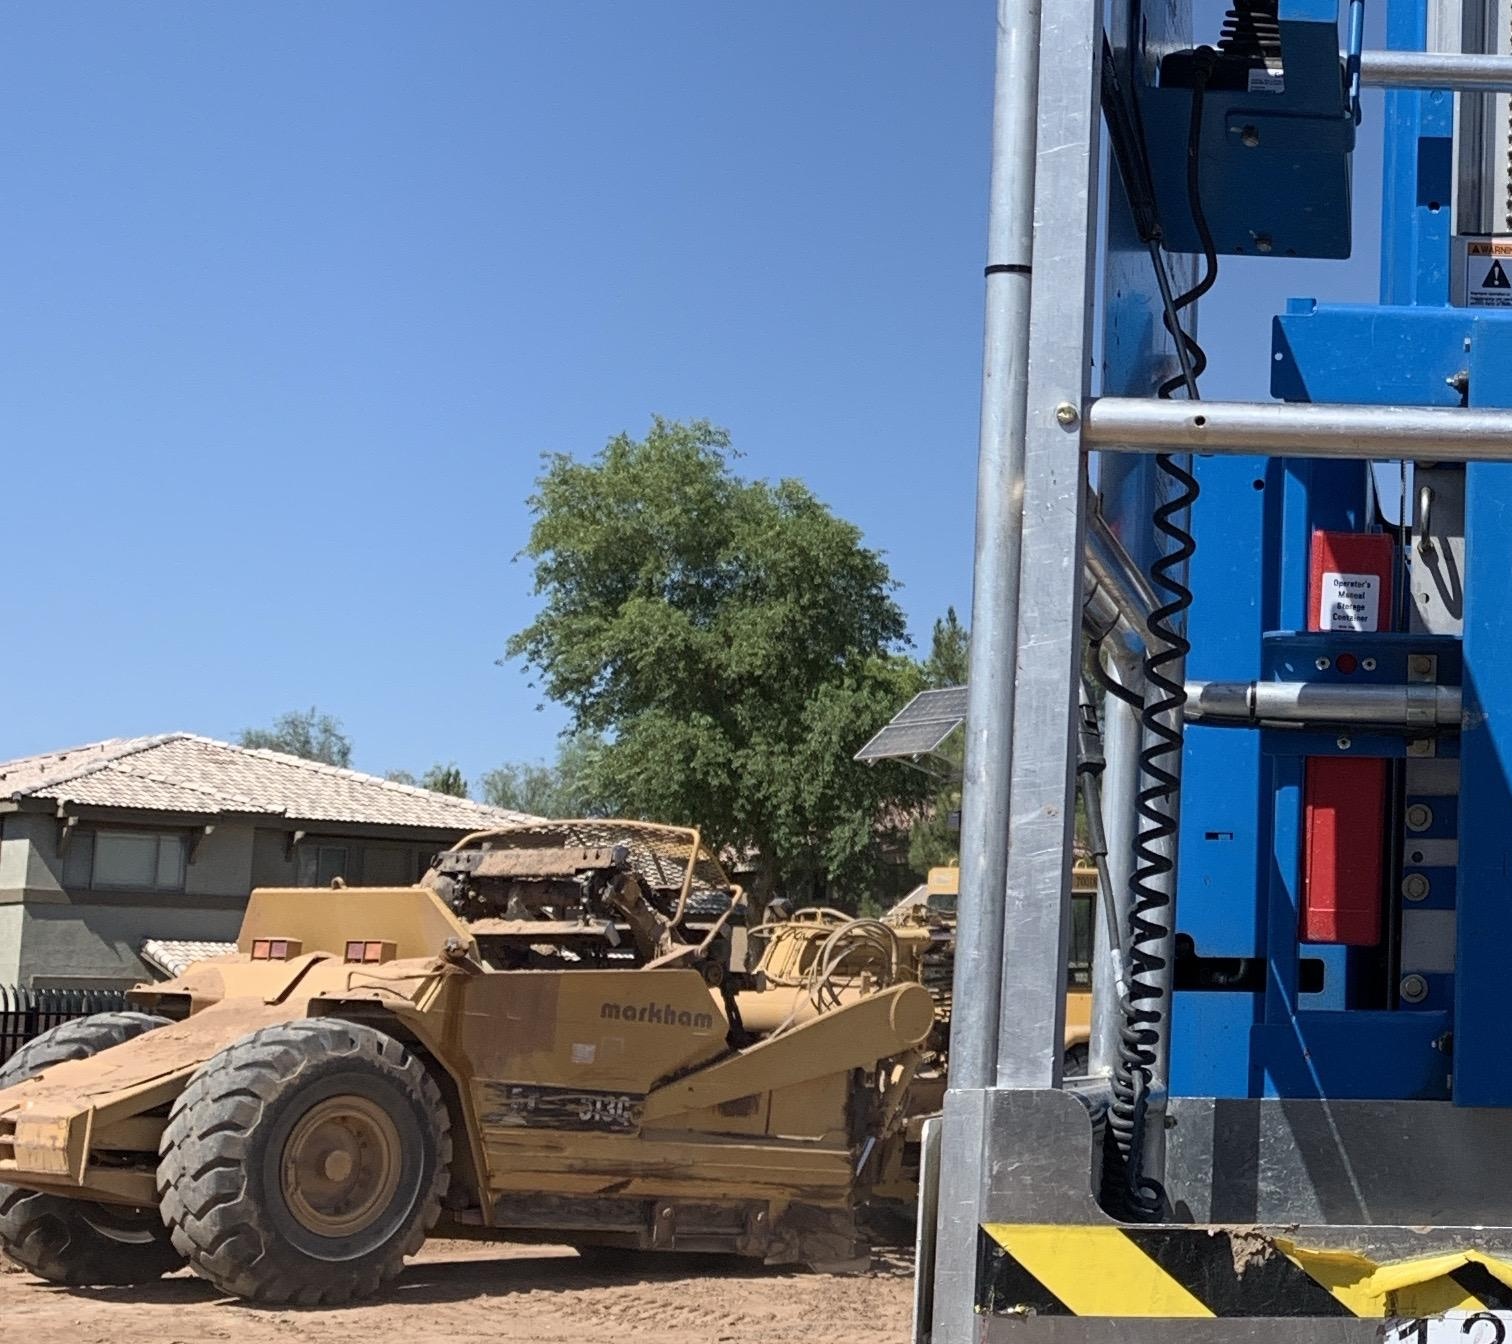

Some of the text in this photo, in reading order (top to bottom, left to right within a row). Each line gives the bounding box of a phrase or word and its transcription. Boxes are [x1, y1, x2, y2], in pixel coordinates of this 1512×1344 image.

[1333, 579, 1371, 589] Operator's
[1338, 591, 1366, 600] Manual
[1337, 602, 1366, 612] Storage
[1332, 613, 1368, 623] Container
[600, 1002, 714, 1029] markham
